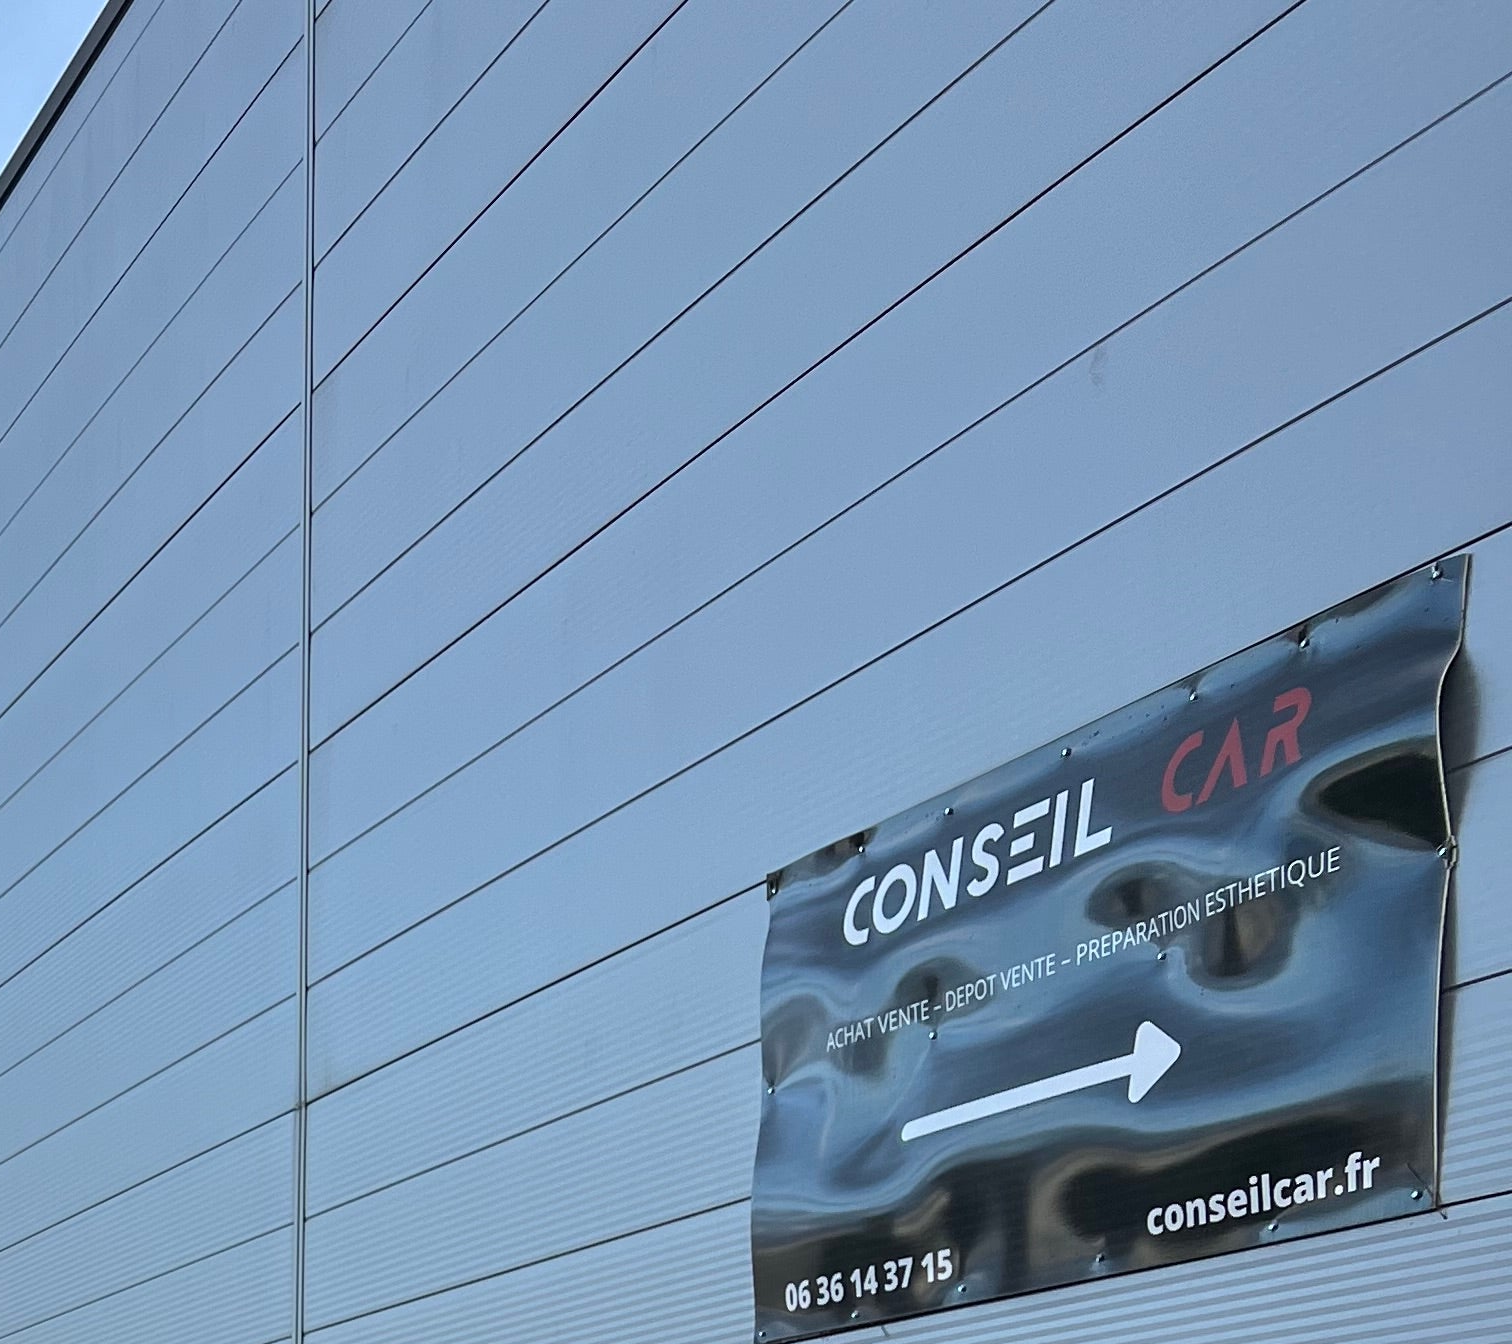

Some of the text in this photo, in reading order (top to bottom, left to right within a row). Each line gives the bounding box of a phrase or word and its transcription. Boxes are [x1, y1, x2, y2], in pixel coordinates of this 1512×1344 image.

[843, 686, 1313, 946] CONSEIL CAR
[826, 1017, 875, 1053] ACHAT
[877, 999, 930, 1035] VENTE
[945, 973, 998, 1013] DEPOT
[999, 952, 1057, 991] VENTE
[1075, 898, 1201, 967] PREPARATION
[1204, 845, 1342, 918] ESTHETIQUE
[1145, 1151, 1381, 1237] conseilcar.fr
[785, 1248, 954, 1313] 06 36 14 37 15
